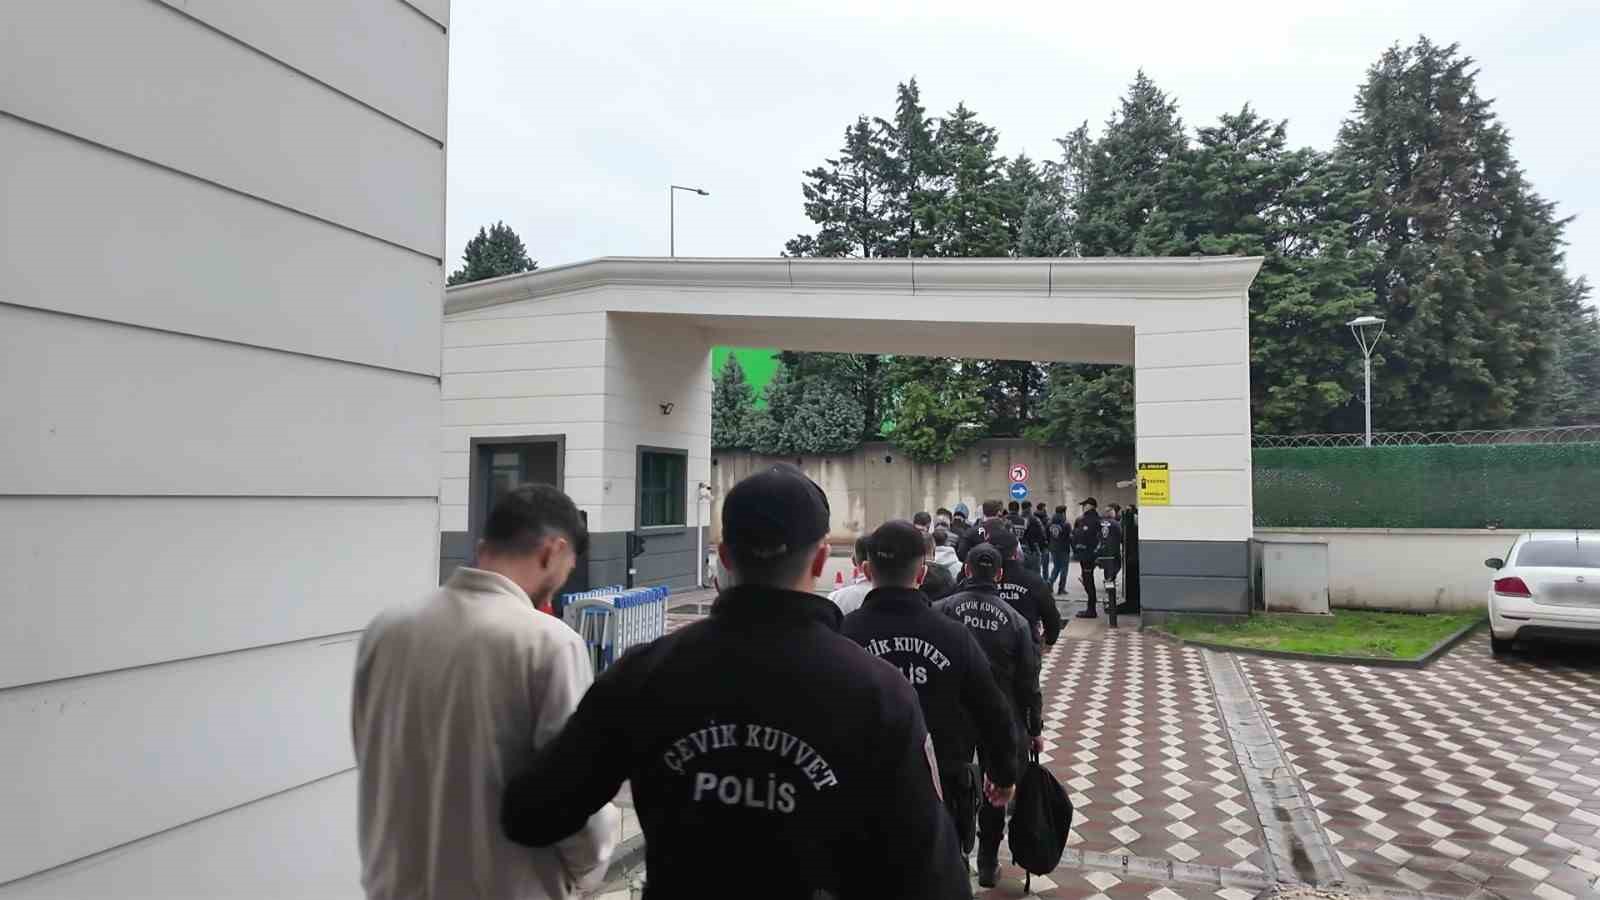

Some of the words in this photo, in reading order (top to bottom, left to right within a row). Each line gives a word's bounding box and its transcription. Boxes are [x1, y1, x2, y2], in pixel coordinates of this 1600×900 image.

[1000, 590, 1020, 600] OLİS
[893, 637, 951, 671] KUVVET
[663, 719, 737, 775] ÇEVİK
[745, 723, 839, 791] KUVVET
[693, 772, 797, 814] POLİS
